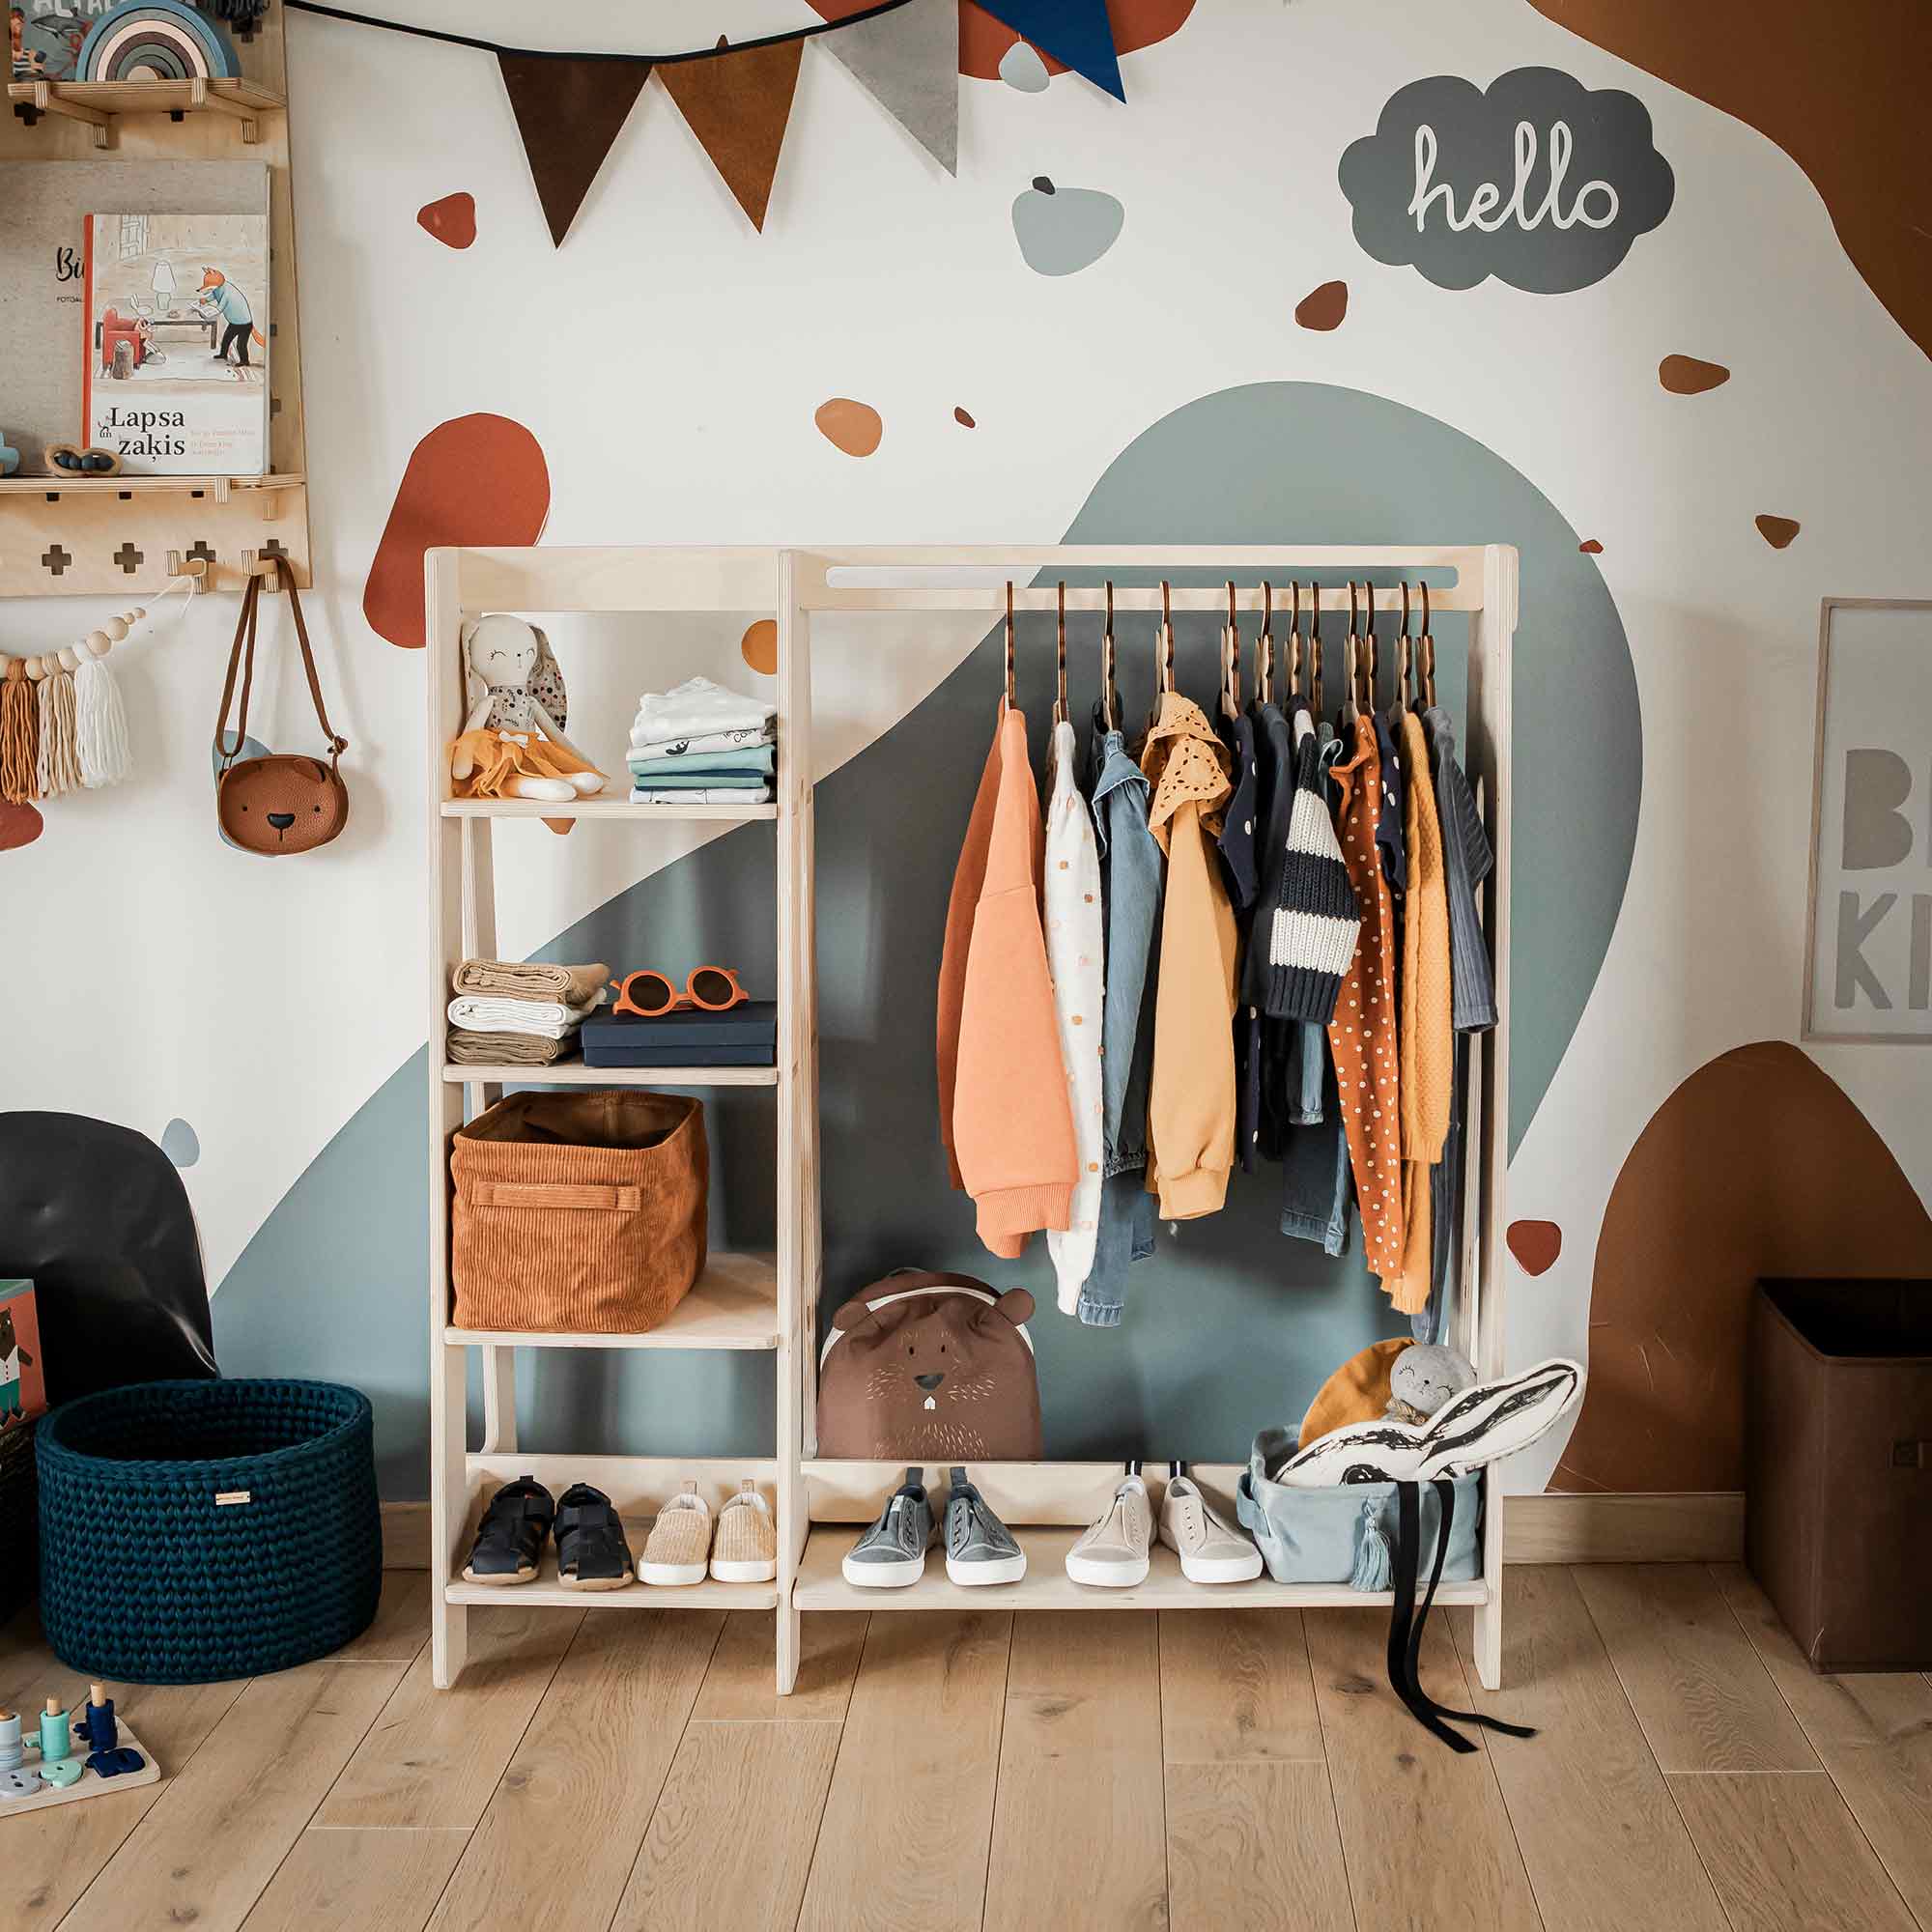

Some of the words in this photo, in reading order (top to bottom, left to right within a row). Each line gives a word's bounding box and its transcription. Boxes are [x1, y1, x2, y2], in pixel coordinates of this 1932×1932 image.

[1407, 121, 1619, 233] hello
[109, 407, 185, 434] Lapsa
[118, 434, 185, 463] zaķis
[1841, 748, 1932, 869] B
